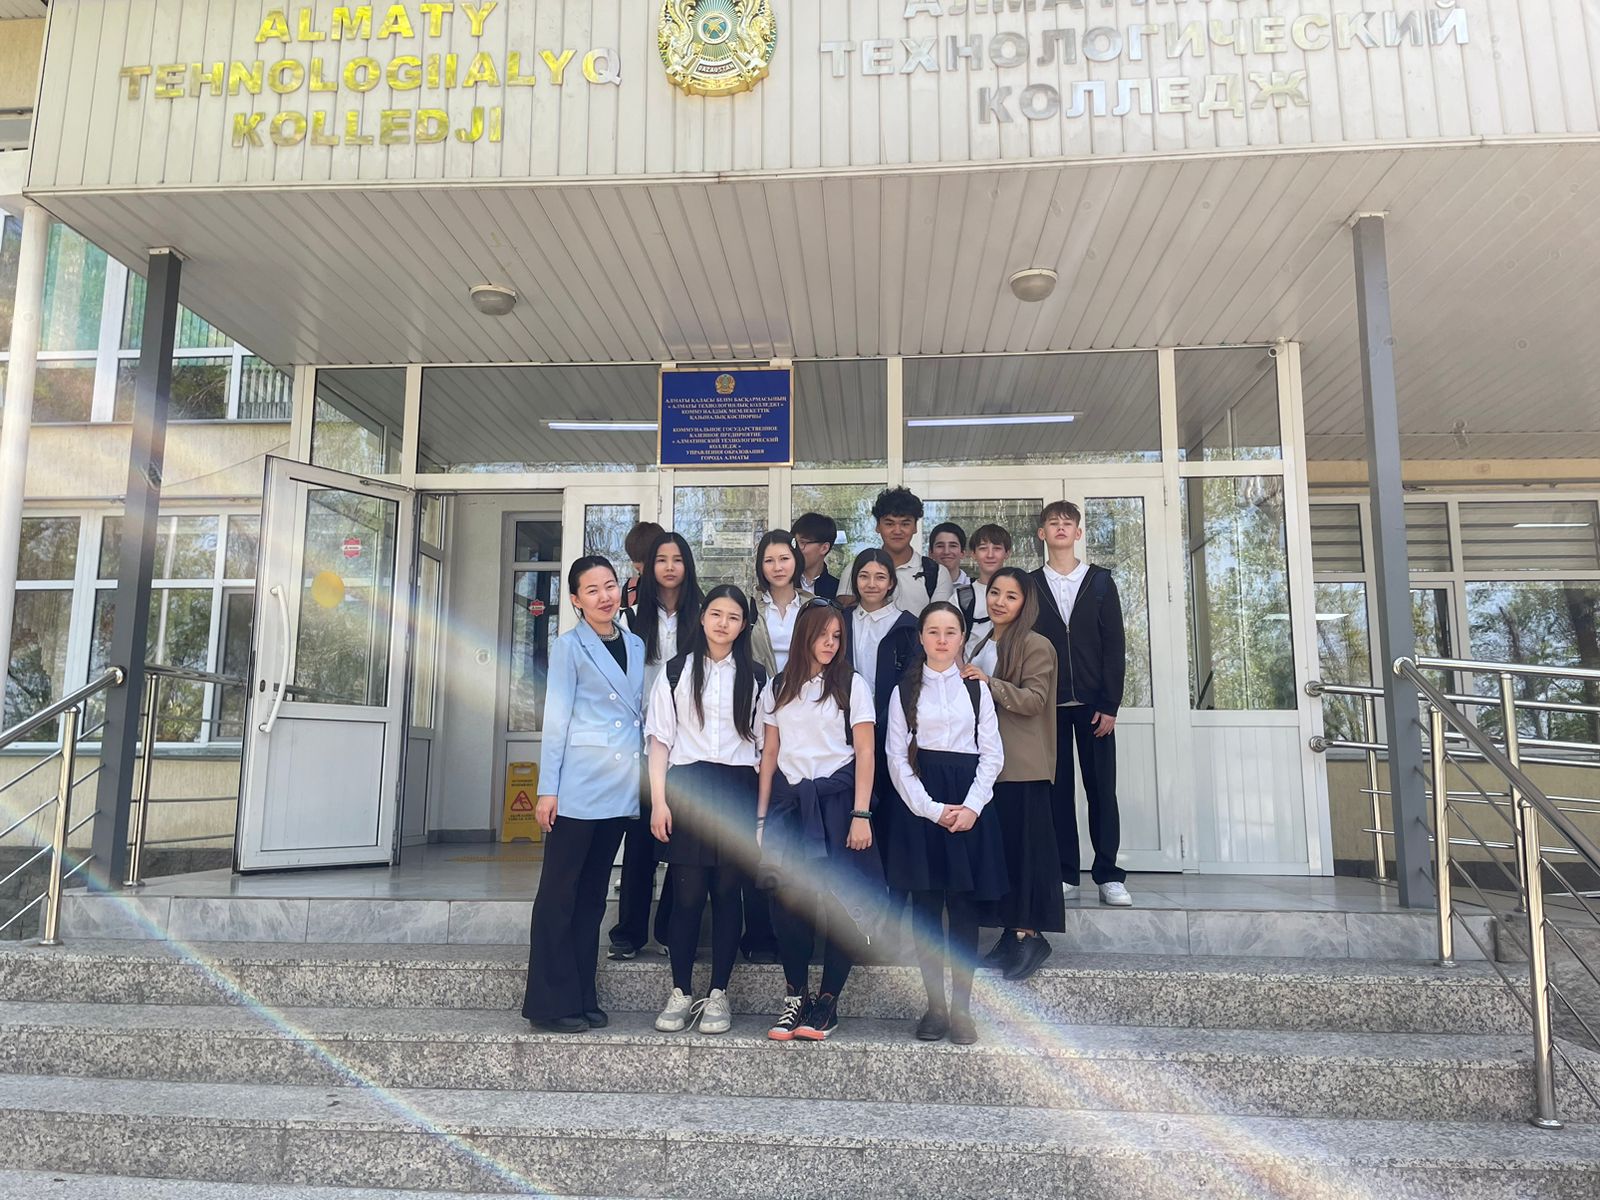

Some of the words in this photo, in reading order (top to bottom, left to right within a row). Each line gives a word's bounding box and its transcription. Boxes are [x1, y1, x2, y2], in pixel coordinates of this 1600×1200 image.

[254, 1, 498, 43] ALMATY
[820, 0, 1470, 78] ТЕХНОЛОГИЧЕСКИЙ
[119, 48, 622, 101] TEHNOLOGIIALYQ
[978, 69, 1310, 124] КОЛЛЕДЖ
[231, 106, 503, 148] KOLLEDJI
